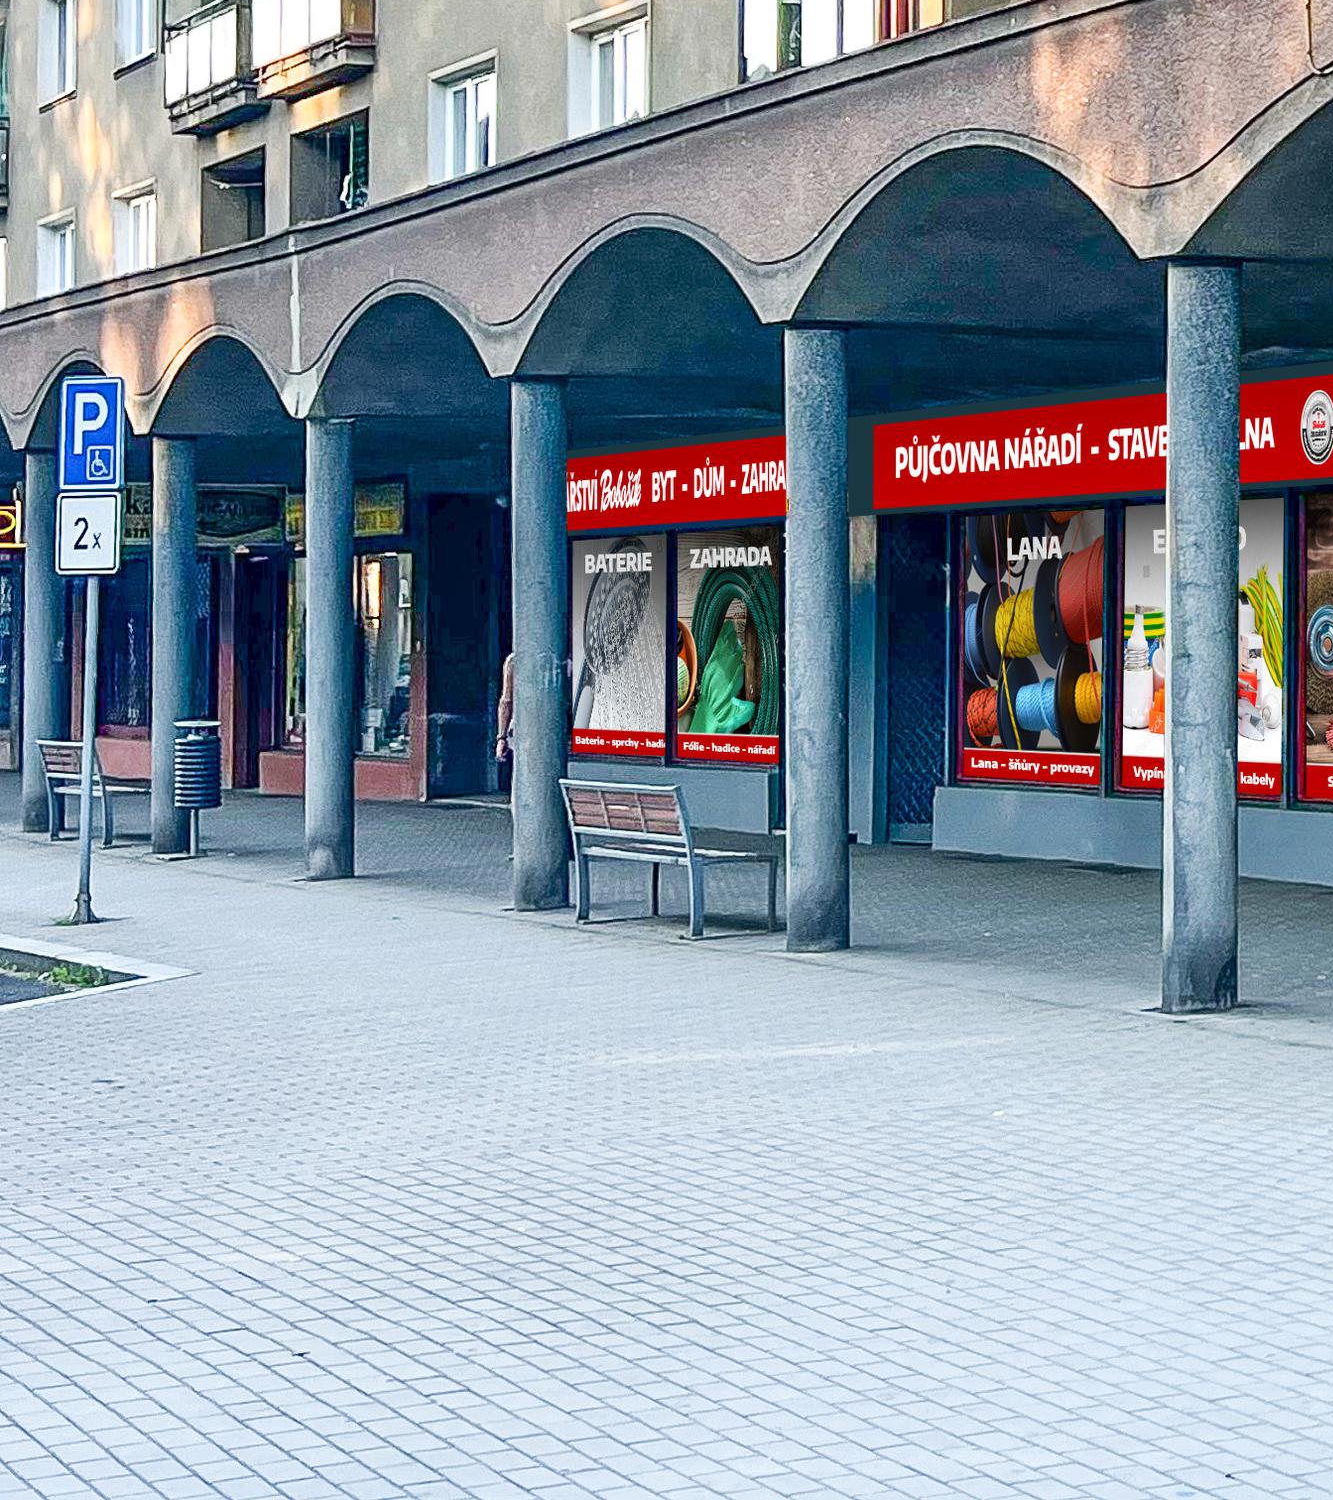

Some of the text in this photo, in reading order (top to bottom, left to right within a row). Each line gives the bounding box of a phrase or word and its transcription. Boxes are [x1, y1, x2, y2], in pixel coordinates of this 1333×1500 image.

[74, 392, 109, 454] P
[895, 435, 1000, 483] PŮJČOVNA
[1004, 423, 1083, 470] NÁŘADÍ
[1108, 425, 1167, 461] STAVE
[652, 470, 677, 502] BYT
[694, 457, 724, 498] DŮM
[741, 460, 786, 494] ZAHRA
[690, 546, 772, 569] ZAHRADA
[1006, 536, 1062, 561] LANA
[584, 552, 652, 574] BATERIE
[575, 736, 605, 746] Baterie
[612, 739, 639, 749] sprchy
[646, 739, 665, 748] hadi
[683, 741, 705, 751] Fólie
[711, 742, 740, 753] hadice
[748, 744, 777, 755] nářadí
[971, 757, 998, 769] Lana
[1008, 758, 1040, 775] šňůry
[1050, 762, 1095, 777] provazy
[1133, 766, 1275, 789] Vypín kabely
